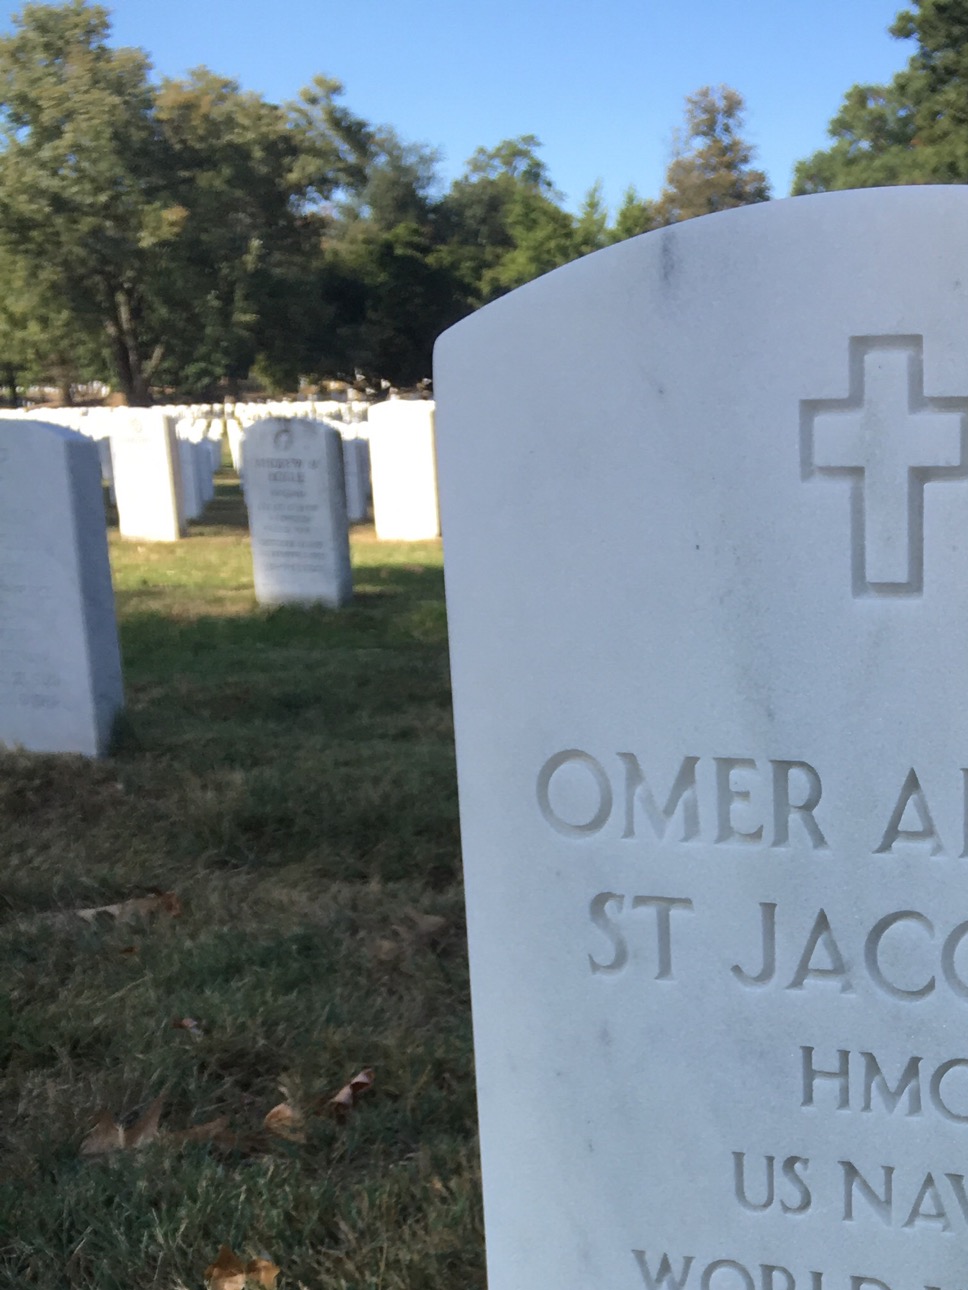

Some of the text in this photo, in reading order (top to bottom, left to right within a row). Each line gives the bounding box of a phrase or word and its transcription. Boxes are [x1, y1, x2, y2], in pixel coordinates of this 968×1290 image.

[535, 748, 828, 850] OMER
[587, 891, 693, 981] ST
[731, 1151, 813, 1215] US
